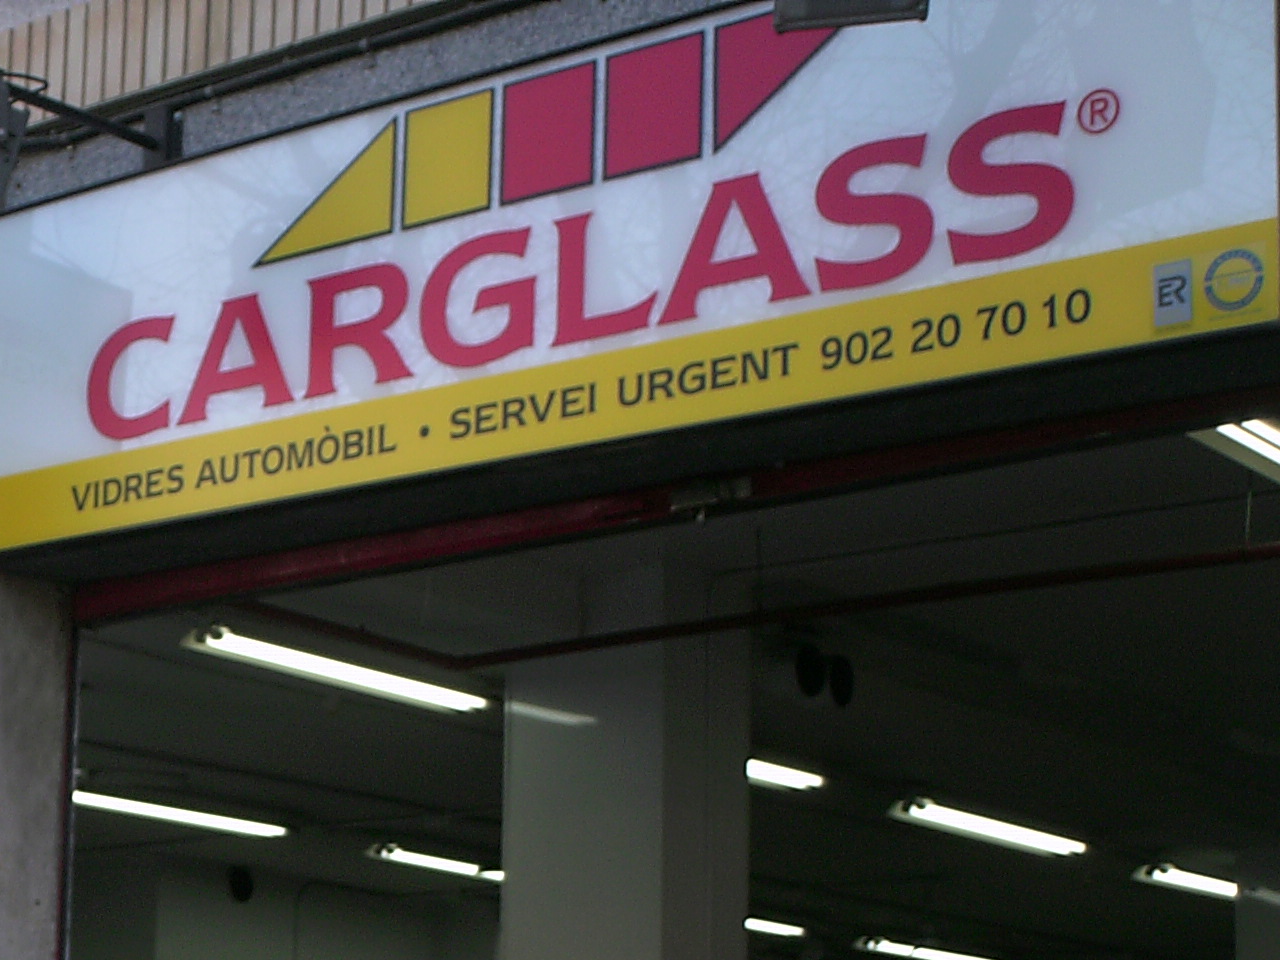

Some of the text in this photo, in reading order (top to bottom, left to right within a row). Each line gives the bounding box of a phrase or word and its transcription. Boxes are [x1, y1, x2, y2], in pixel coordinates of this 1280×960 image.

[71, 290, 1092, 512] VIDRES AUTOMÒBIL SERVEI URGENT 902 20 70 10
